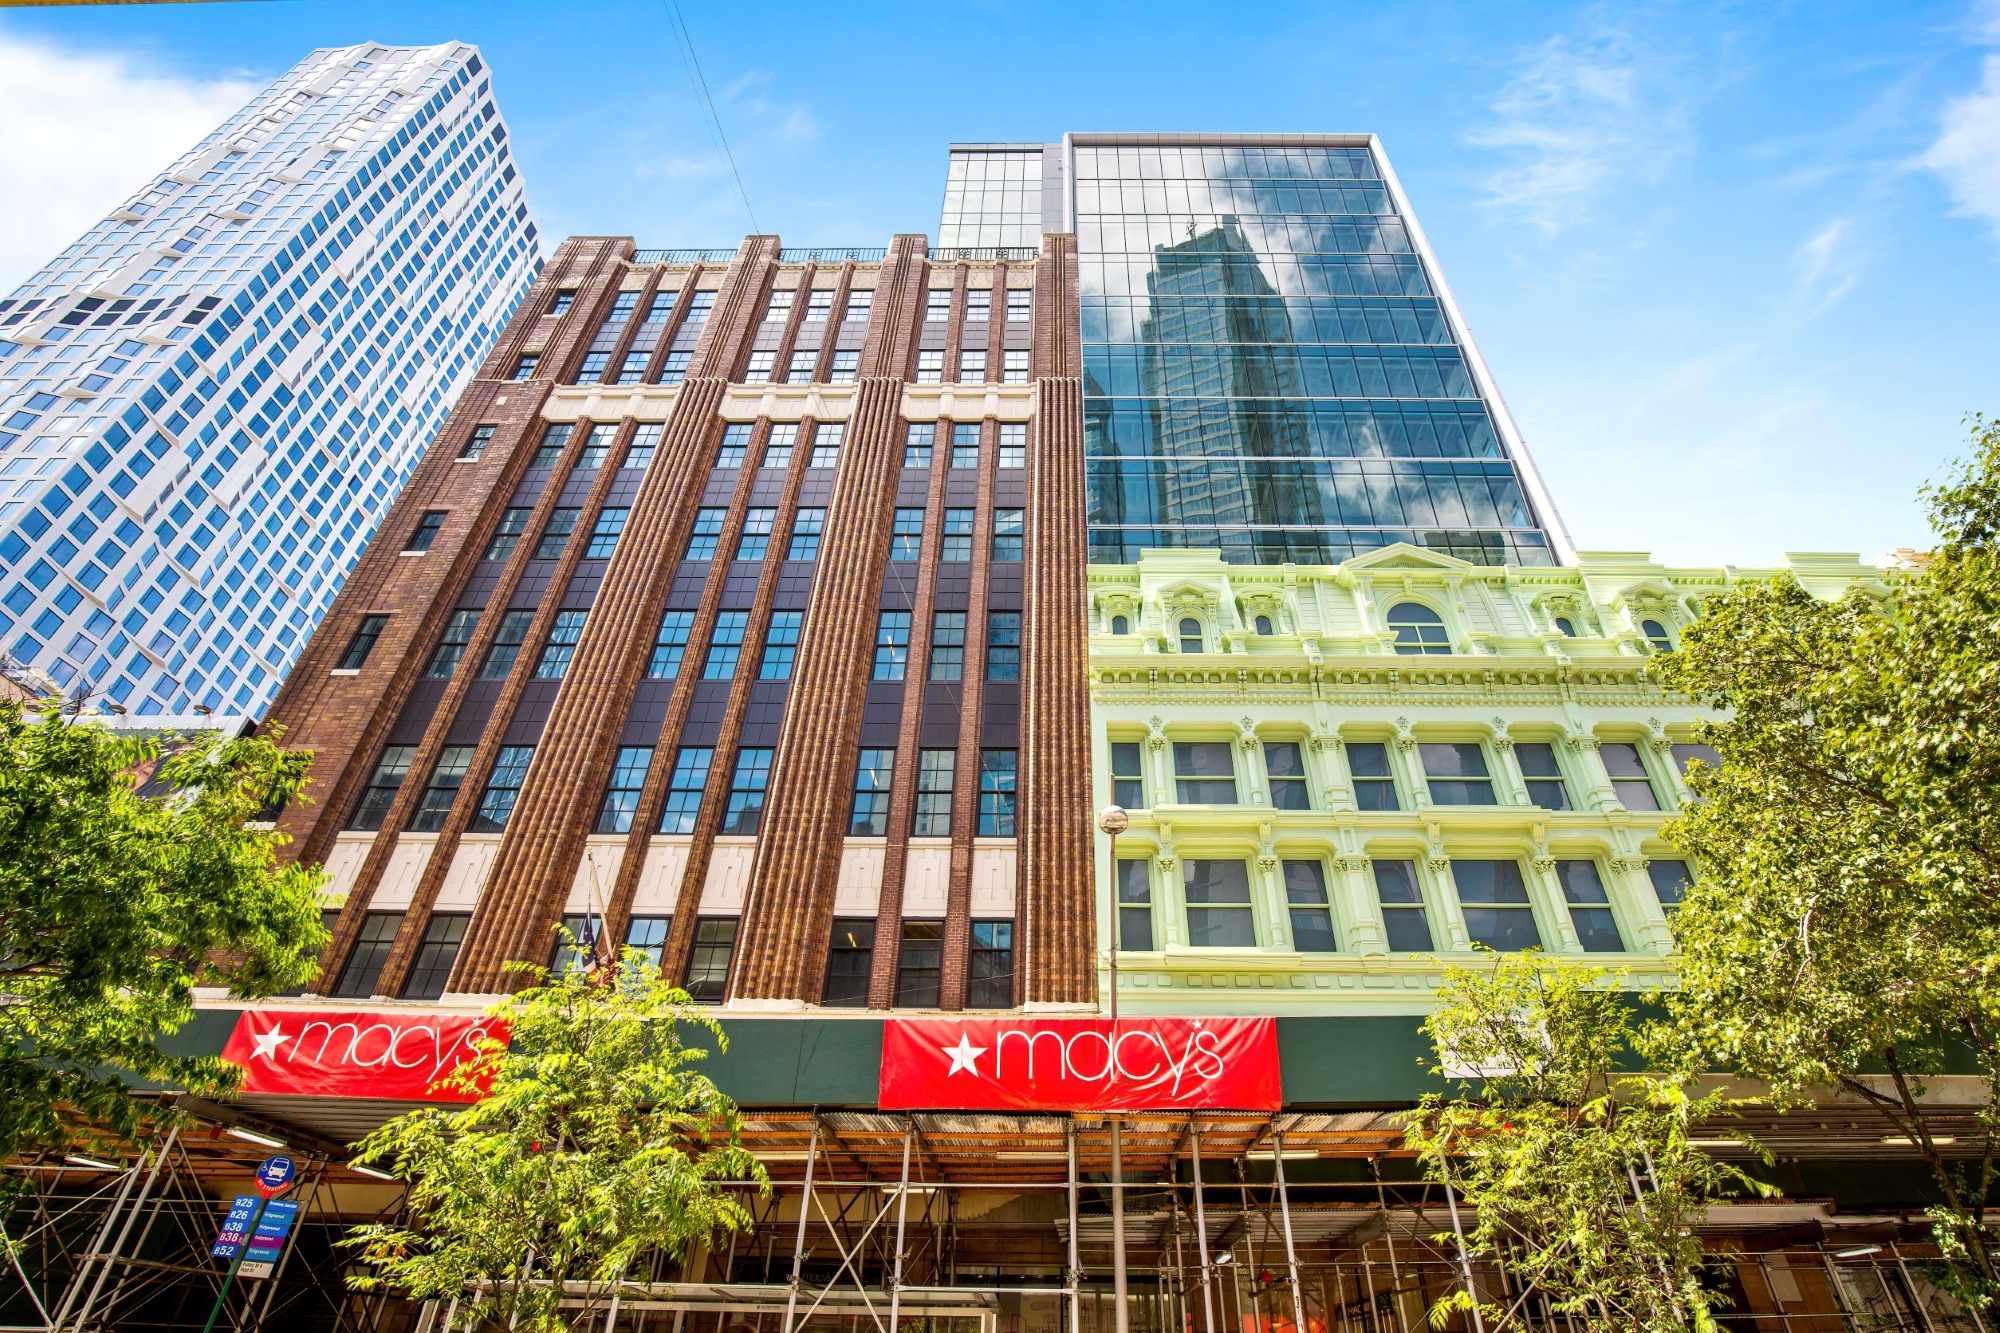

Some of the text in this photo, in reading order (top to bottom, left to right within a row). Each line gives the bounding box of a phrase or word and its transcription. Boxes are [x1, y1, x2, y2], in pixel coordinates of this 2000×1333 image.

[261, 1182, 288, 1192] STANDING
[235, 1198, 254, 1208] B25
[229, 1210, 249, 1220] B26
[264, 1211, 285, 1219] Ridgewood
[224, 1222, 243, 1232] B38
[219, 1232, 239, 1242] B38
[213, 1245, 234, 1256] B52
[248, 1247, 270, 1255] Ridgewood
